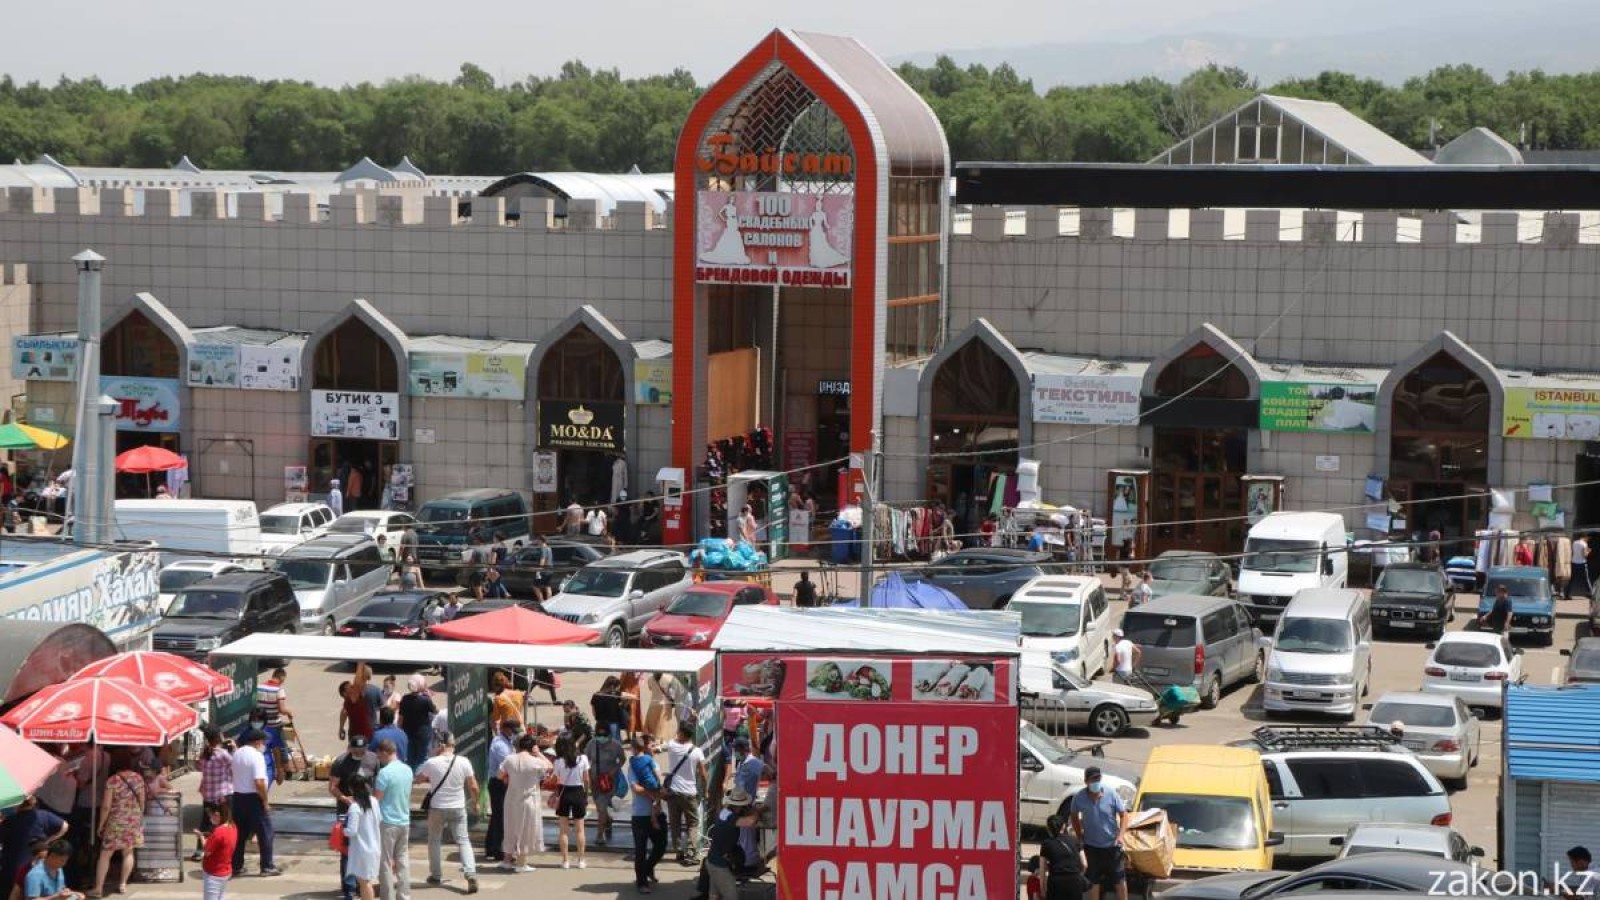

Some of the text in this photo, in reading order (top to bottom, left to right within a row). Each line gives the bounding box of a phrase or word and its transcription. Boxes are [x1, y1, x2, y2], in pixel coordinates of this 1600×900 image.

[757, 195, 791, 216] 100
[739, 215, 811, 230] СВАДЕБНЫХ
[744, 232, 804, 246] САЛОНОВ
[768, 251, 777, 264] И
[696, 267, 848, 286] БРЕНДОВОЙ ОДЕЖДЫ
[326, 392, 383, 405] БУТИК 3
[1036, 387, 1138, 404] ТЕКСТИЛЬ
[1535, 390, 1600, 403] ISTANBUL
[551, 424, 613, 441] MO&DA
[454, 672, 470, 695] STOP
[454, 688, 484, 719] COVID-19
[806, 723, 979, 781] ДОНЕР
[785, 797, 1010, 850] ШАУРМА
[807, 860, 989, 900] САМСА
